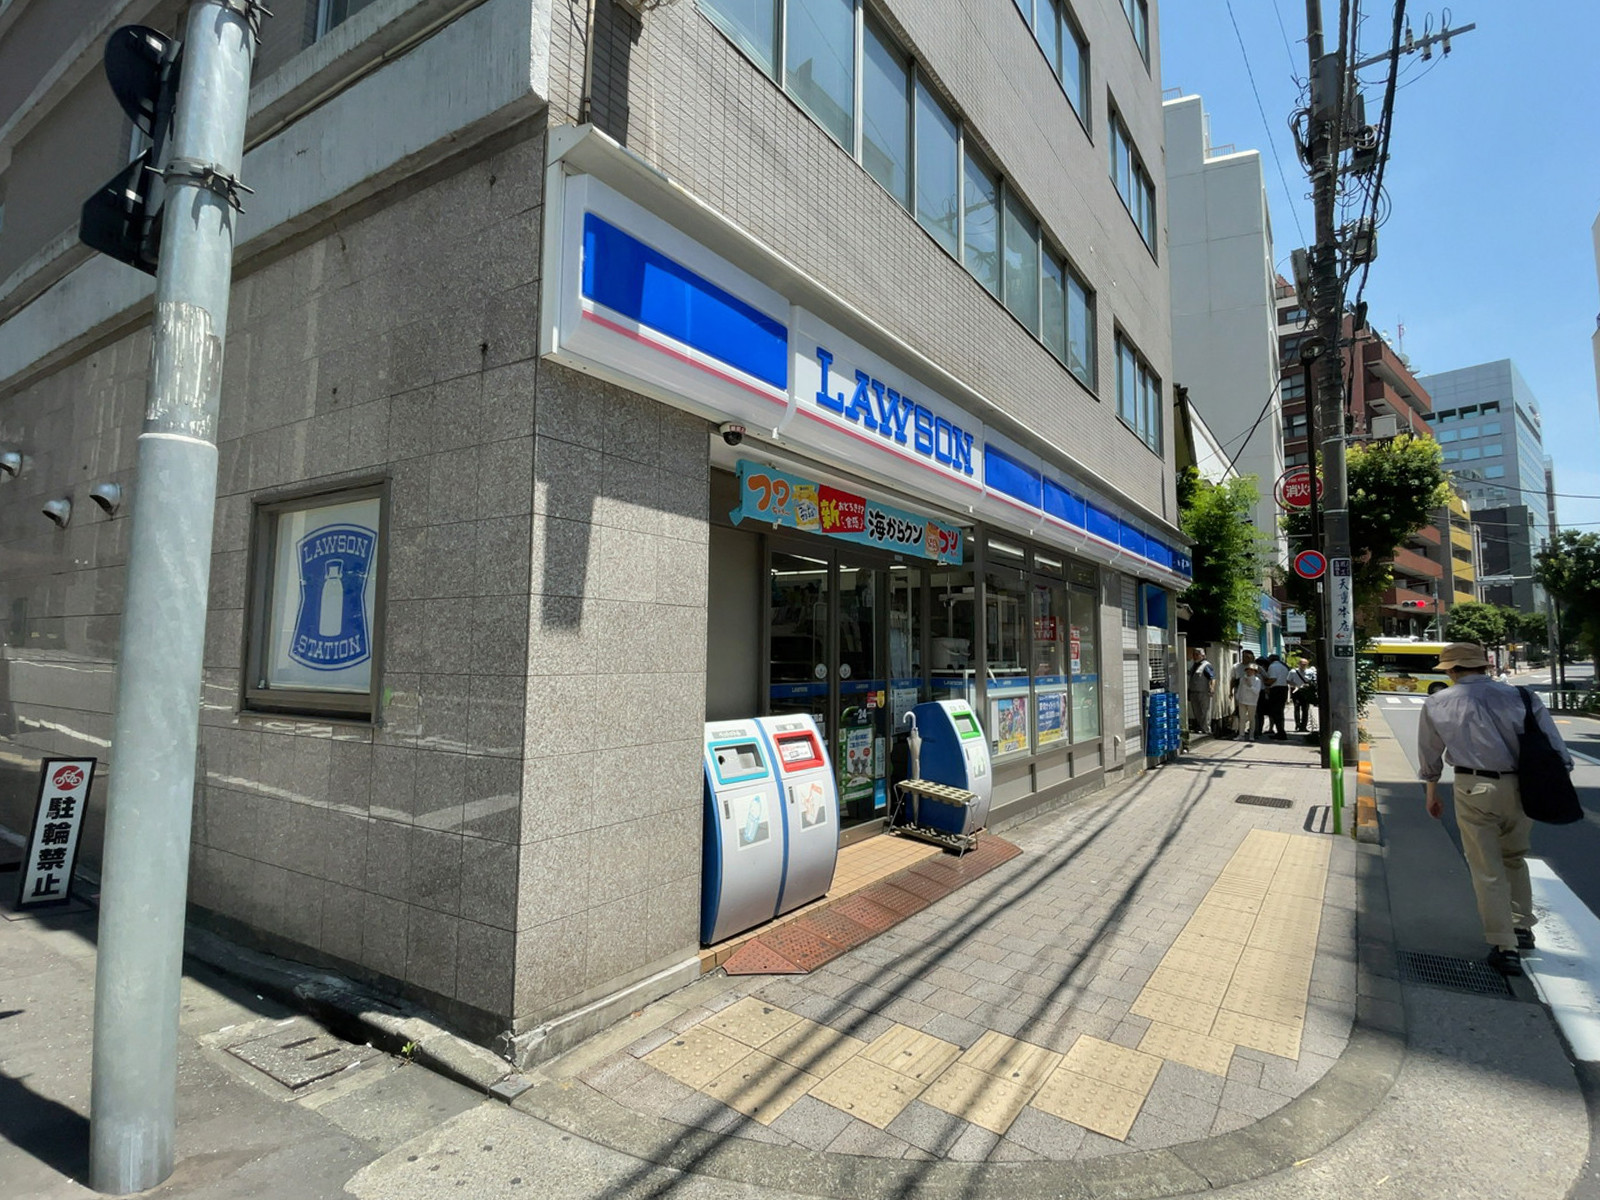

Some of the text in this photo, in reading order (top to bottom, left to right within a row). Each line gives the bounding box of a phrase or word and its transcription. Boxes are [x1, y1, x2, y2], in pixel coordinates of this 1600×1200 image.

[816, 346, 974, 475] LAWSON
[747, 475, 790, 511] フワ
[820, 499, 840, 529] 新
[868, 509, 922, 544] 海からクン
[304, 535, 368, 563] LAWSON
[298, 634, 361, 659] STATION
[857, 708, 867, 719] 24
[31, 796, 76, 897] 駐輪禁止
